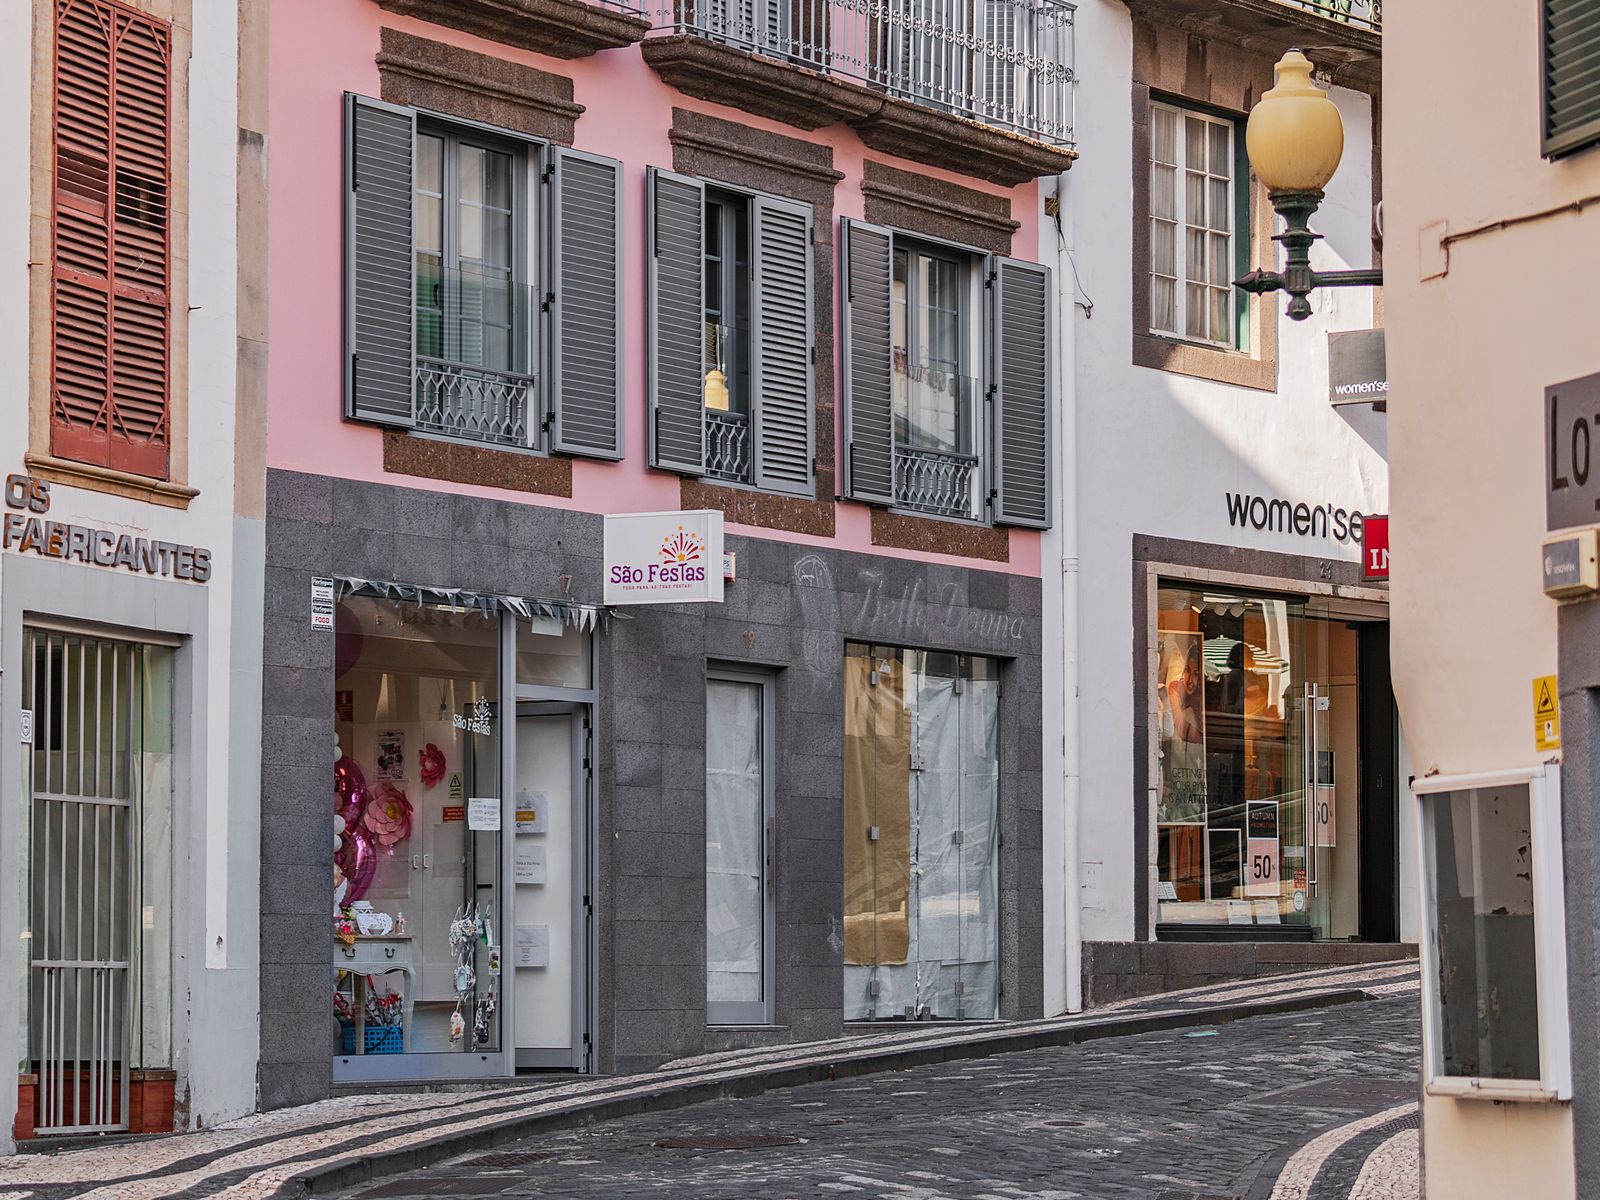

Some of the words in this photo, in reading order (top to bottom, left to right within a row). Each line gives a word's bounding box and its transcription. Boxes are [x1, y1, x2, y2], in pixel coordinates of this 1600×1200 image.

[5, 473, 50, 513] OS
[3, 513, 212, 583] FABRICANTES
[610, 565, 643, 584] São
[315, 616, 330, 624] FOGO
[453, 713, 467, 729] São
[1251, 812, 1275, 820] AUTUMN
